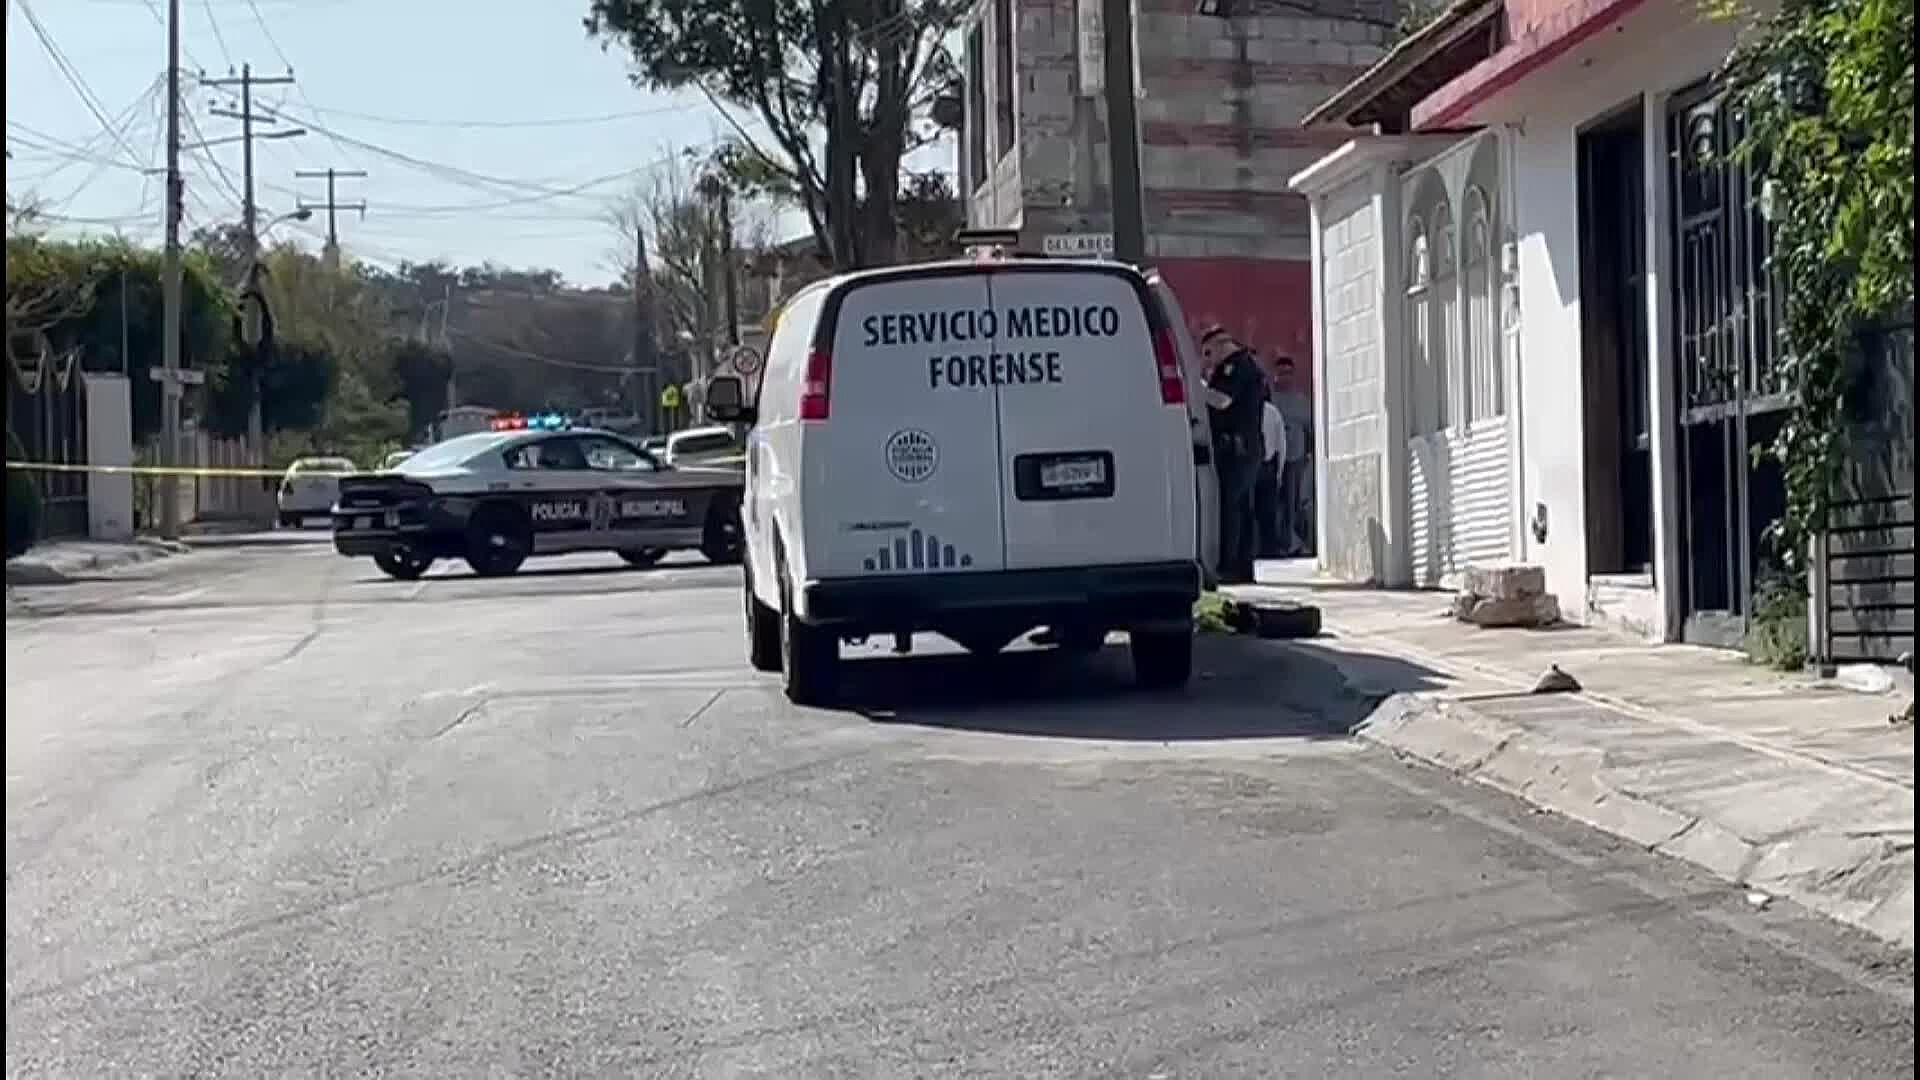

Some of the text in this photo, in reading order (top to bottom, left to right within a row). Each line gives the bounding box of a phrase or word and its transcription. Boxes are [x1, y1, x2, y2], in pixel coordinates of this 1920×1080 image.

[863, 305, 1120, 347] SERVICIO MEDICO
[929, 351, 1063, 388] FORENSE
[621, 498, 687, 519] MUNICIPAL
